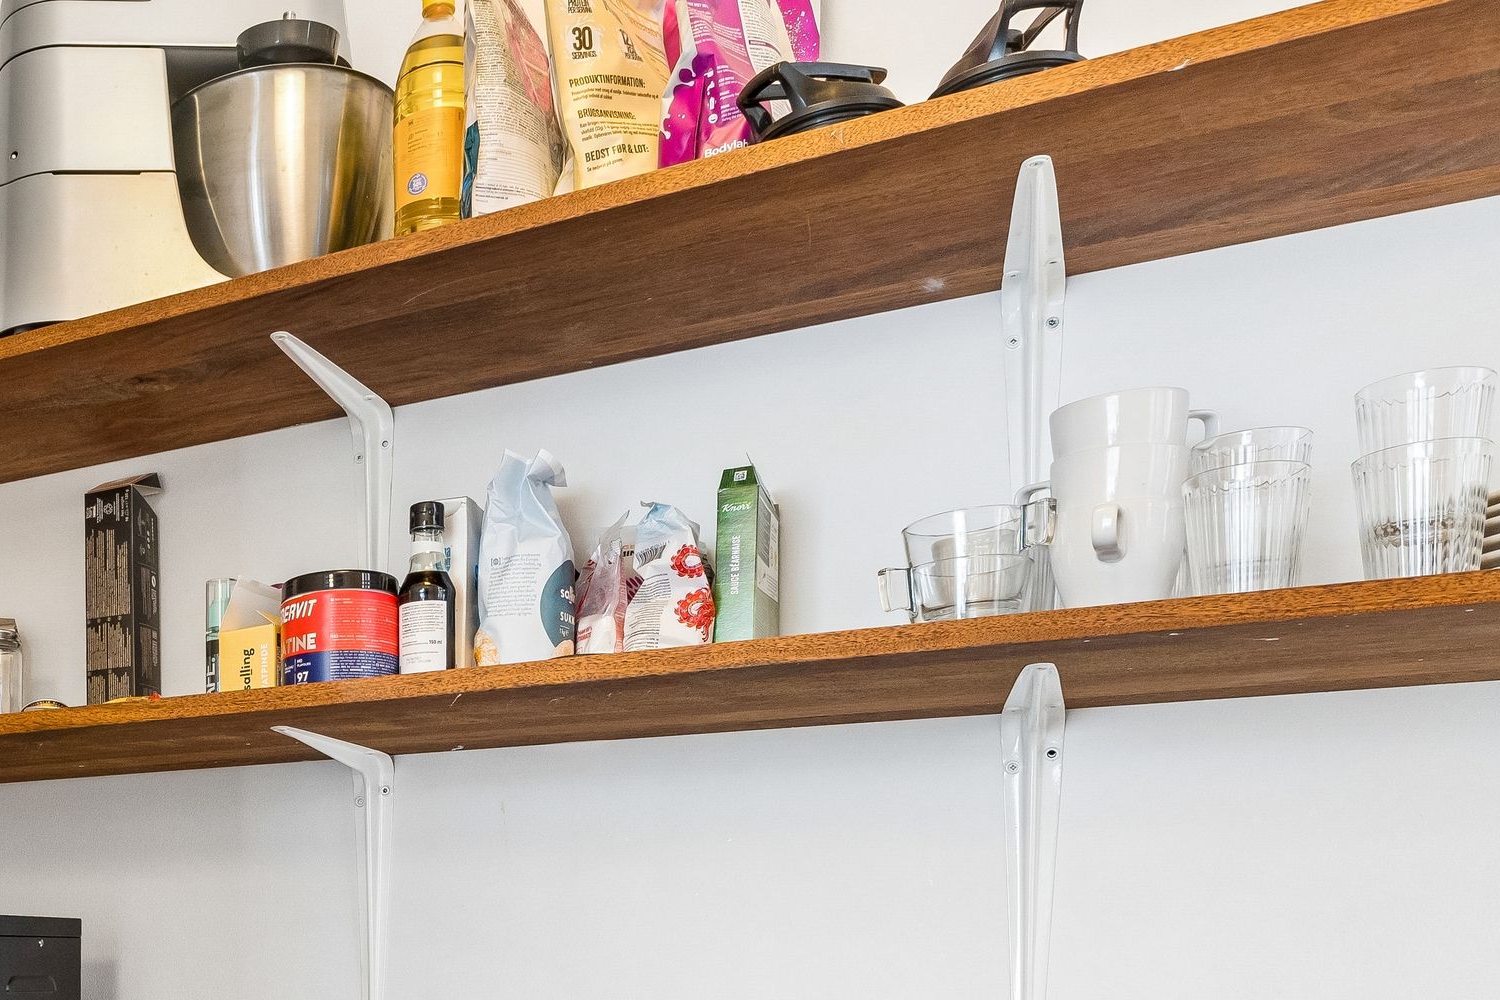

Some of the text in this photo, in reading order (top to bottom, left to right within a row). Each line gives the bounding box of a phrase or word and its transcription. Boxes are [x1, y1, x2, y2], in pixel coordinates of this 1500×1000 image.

[571, 26, 593, 51] 30
[571, 51, 597, 60] SERVINGS
[569, 74, 646, 88] PRODUKTINFORMATION:
[585, 147, 610, 163] BEDST
[627, 144, 634, 154] &
[634, 143, 649, 154] LOT:
[721, 503, 752, 513] Knorr
[730, 573, 740, 595] SAUCE
[239, 648, 255, 691] salling
[260, 643, 269, 688] ATPINDE
[296, 671, 309, 682] 97
